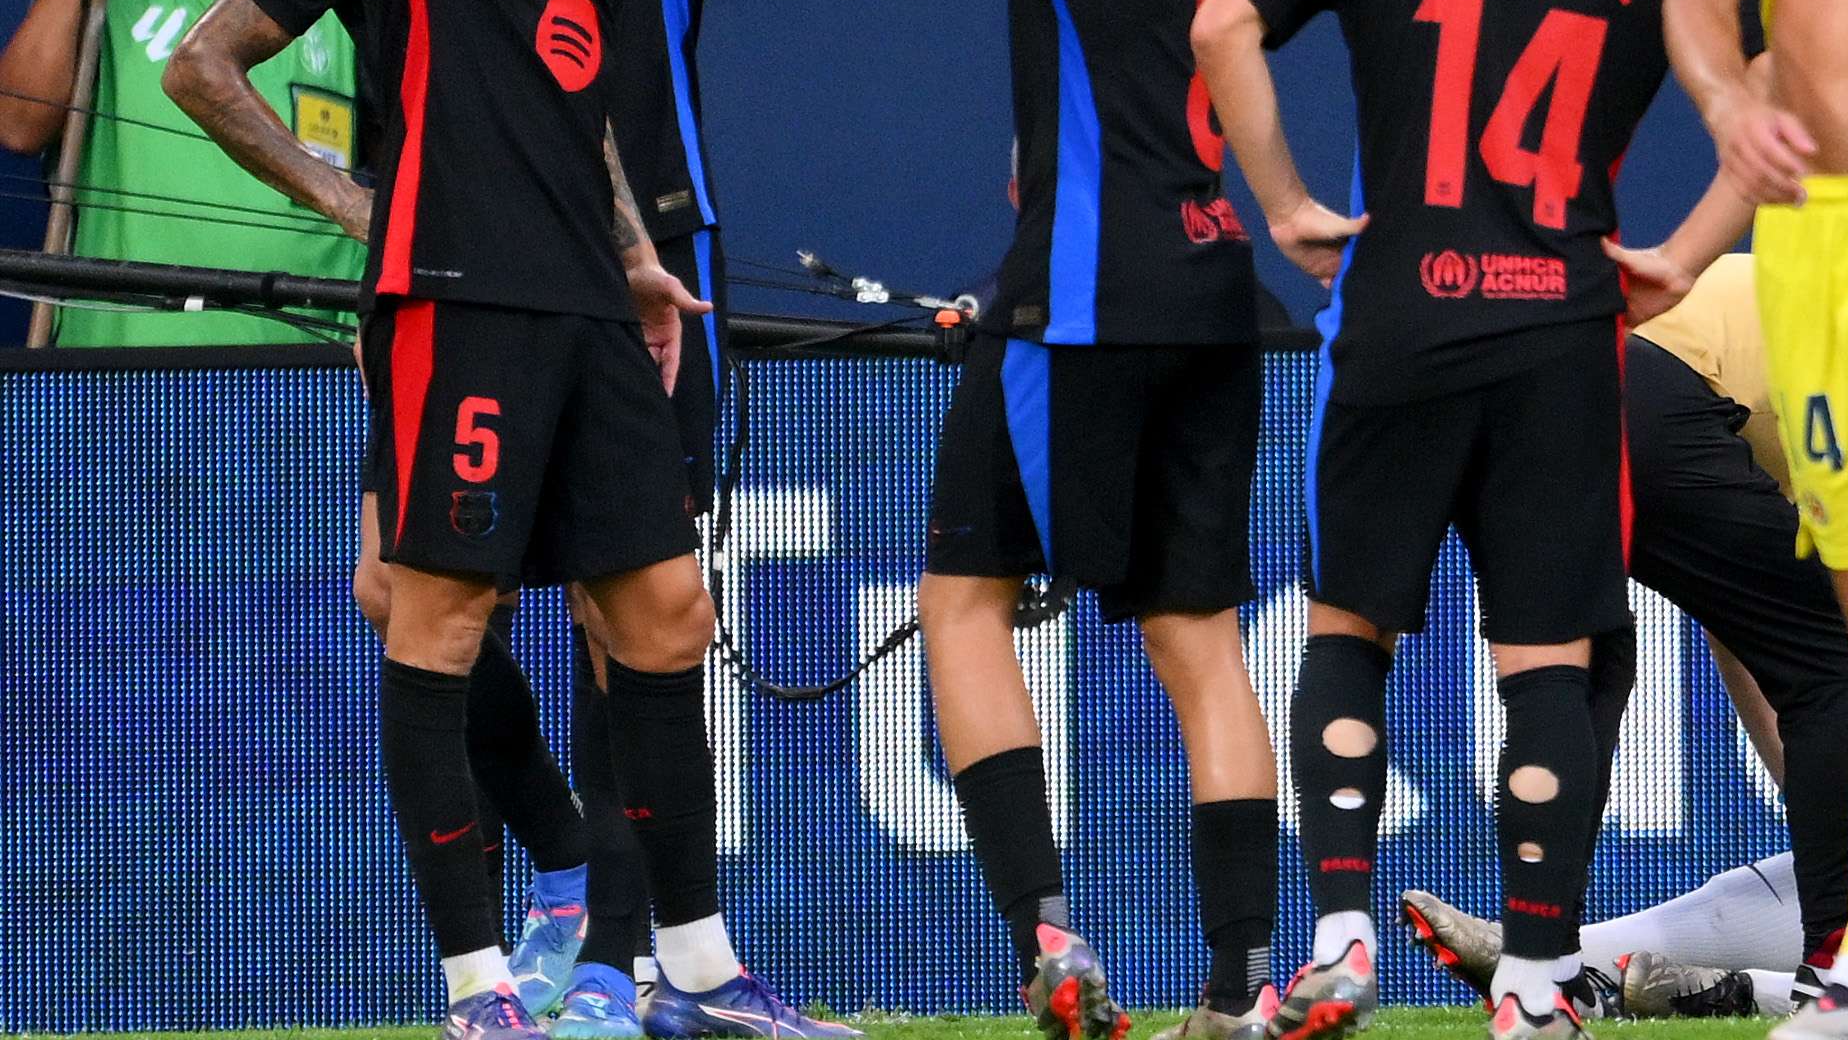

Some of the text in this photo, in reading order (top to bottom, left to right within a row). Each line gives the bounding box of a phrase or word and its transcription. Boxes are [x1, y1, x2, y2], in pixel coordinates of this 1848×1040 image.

[1480, 253, 1566, 274] UNHCR
[1481, 273, 1567, 292] ACNUR
[453, 396, 500, 483] 5
[1804, 394, 1844, 471] 4
